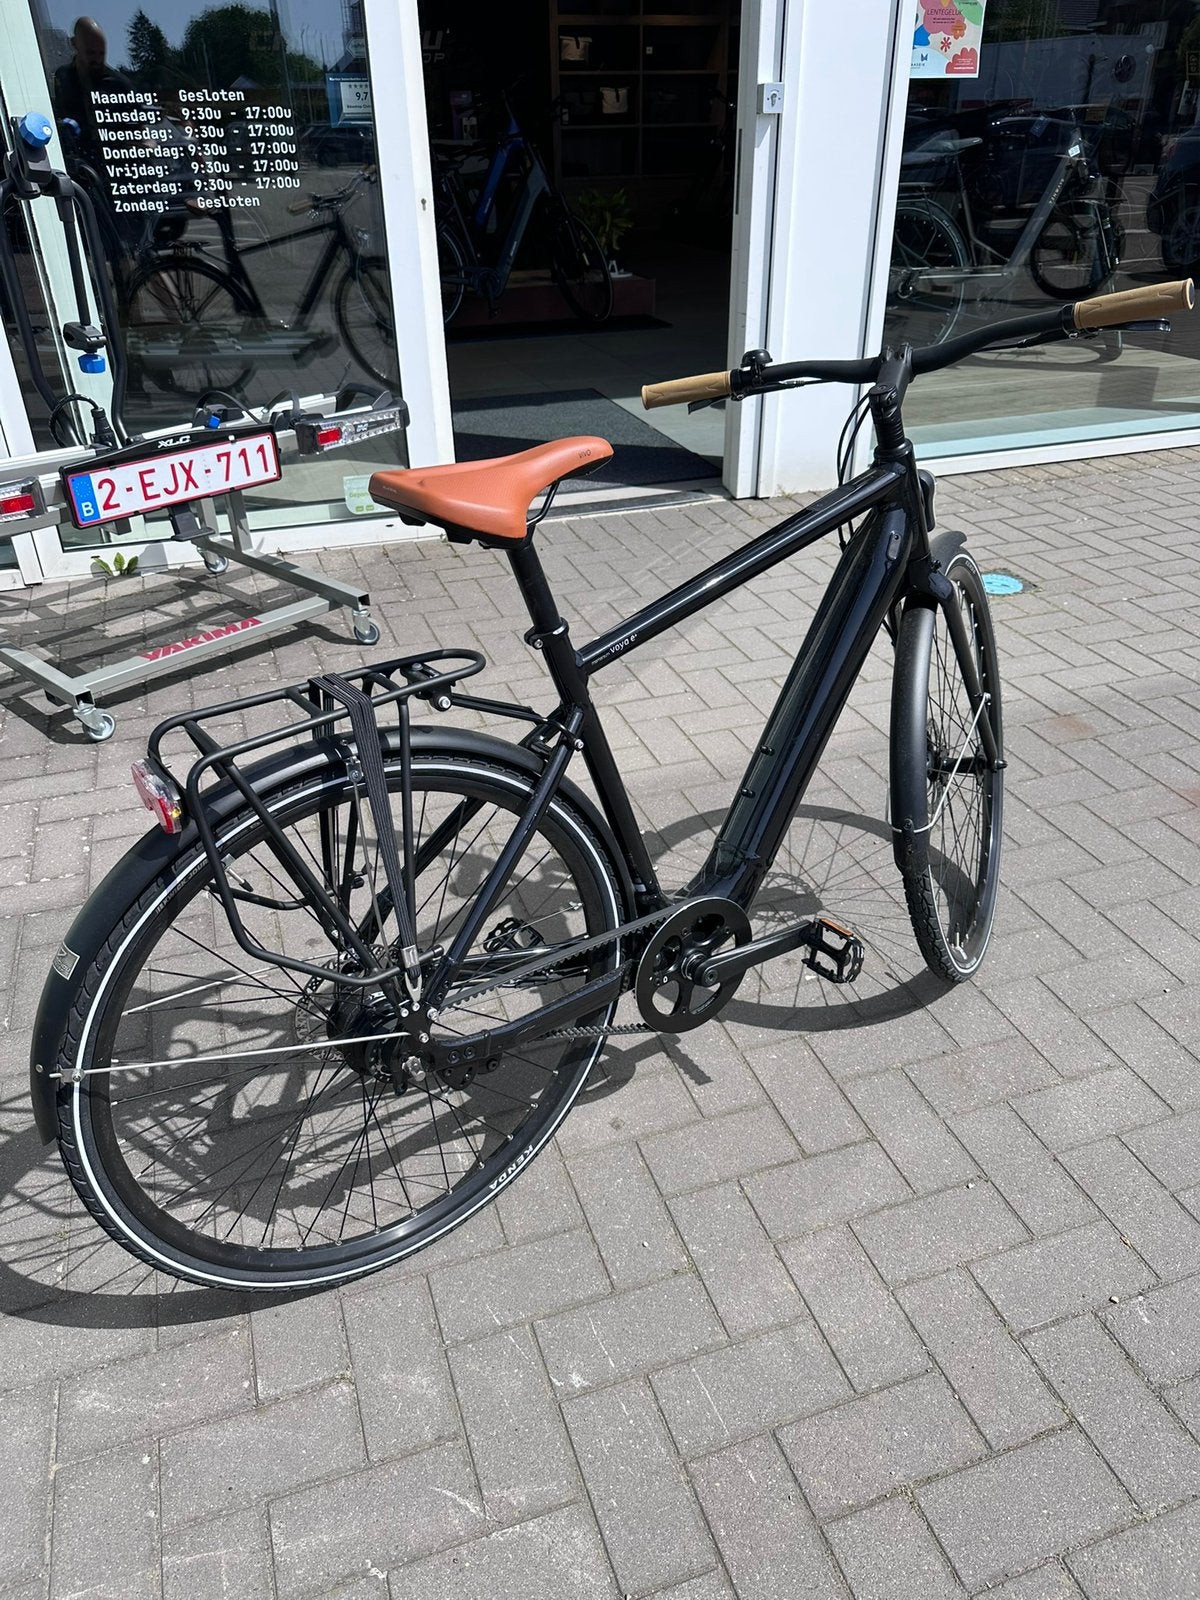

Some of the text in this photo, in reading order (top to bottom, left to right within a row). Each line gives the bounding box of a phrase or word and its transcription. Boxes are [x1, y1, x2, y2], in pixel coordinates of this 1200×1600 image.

[90, 89, 245, 106] Maandag: Gesloten
[355, 91, 369, 101] 9.7
[95, 109, 161, 124] Dinsdag:
[181, 107, 222, 120] 9:30u
[245, 106, 292, 119] 17:00u
[98, 127, 173, 141] Woensdag:
[184, 125, 224, 138] 9:30u
[247, 124, 294, 137] 17:00u
[102, 145, 184, 159] Donderdag:
[187, 143, 227, 156] 9:30u
[250, 141, 296, 155] 17:00u
[106, 163, 169, 179] Vrijdag:
[190, 161, 230, 174] 9:30u
[252, 159, 298, 172] 17:00u
[110, 181, 183, 195] Zaterdag:
[193, 178, 233, 191] 9:30u
[255, 176, 301, 189] 17:00u
[114, 196, 260, 213] Zondag: Gesloten
[157, 435, 191, 449] XLC
[97, 444, 269, 511] 2-EJX-711
[81, 501, 95, 517] B
[142, 617, 263, 661] YAKIMA
[488, 1144, 534, 1190] KENDA
